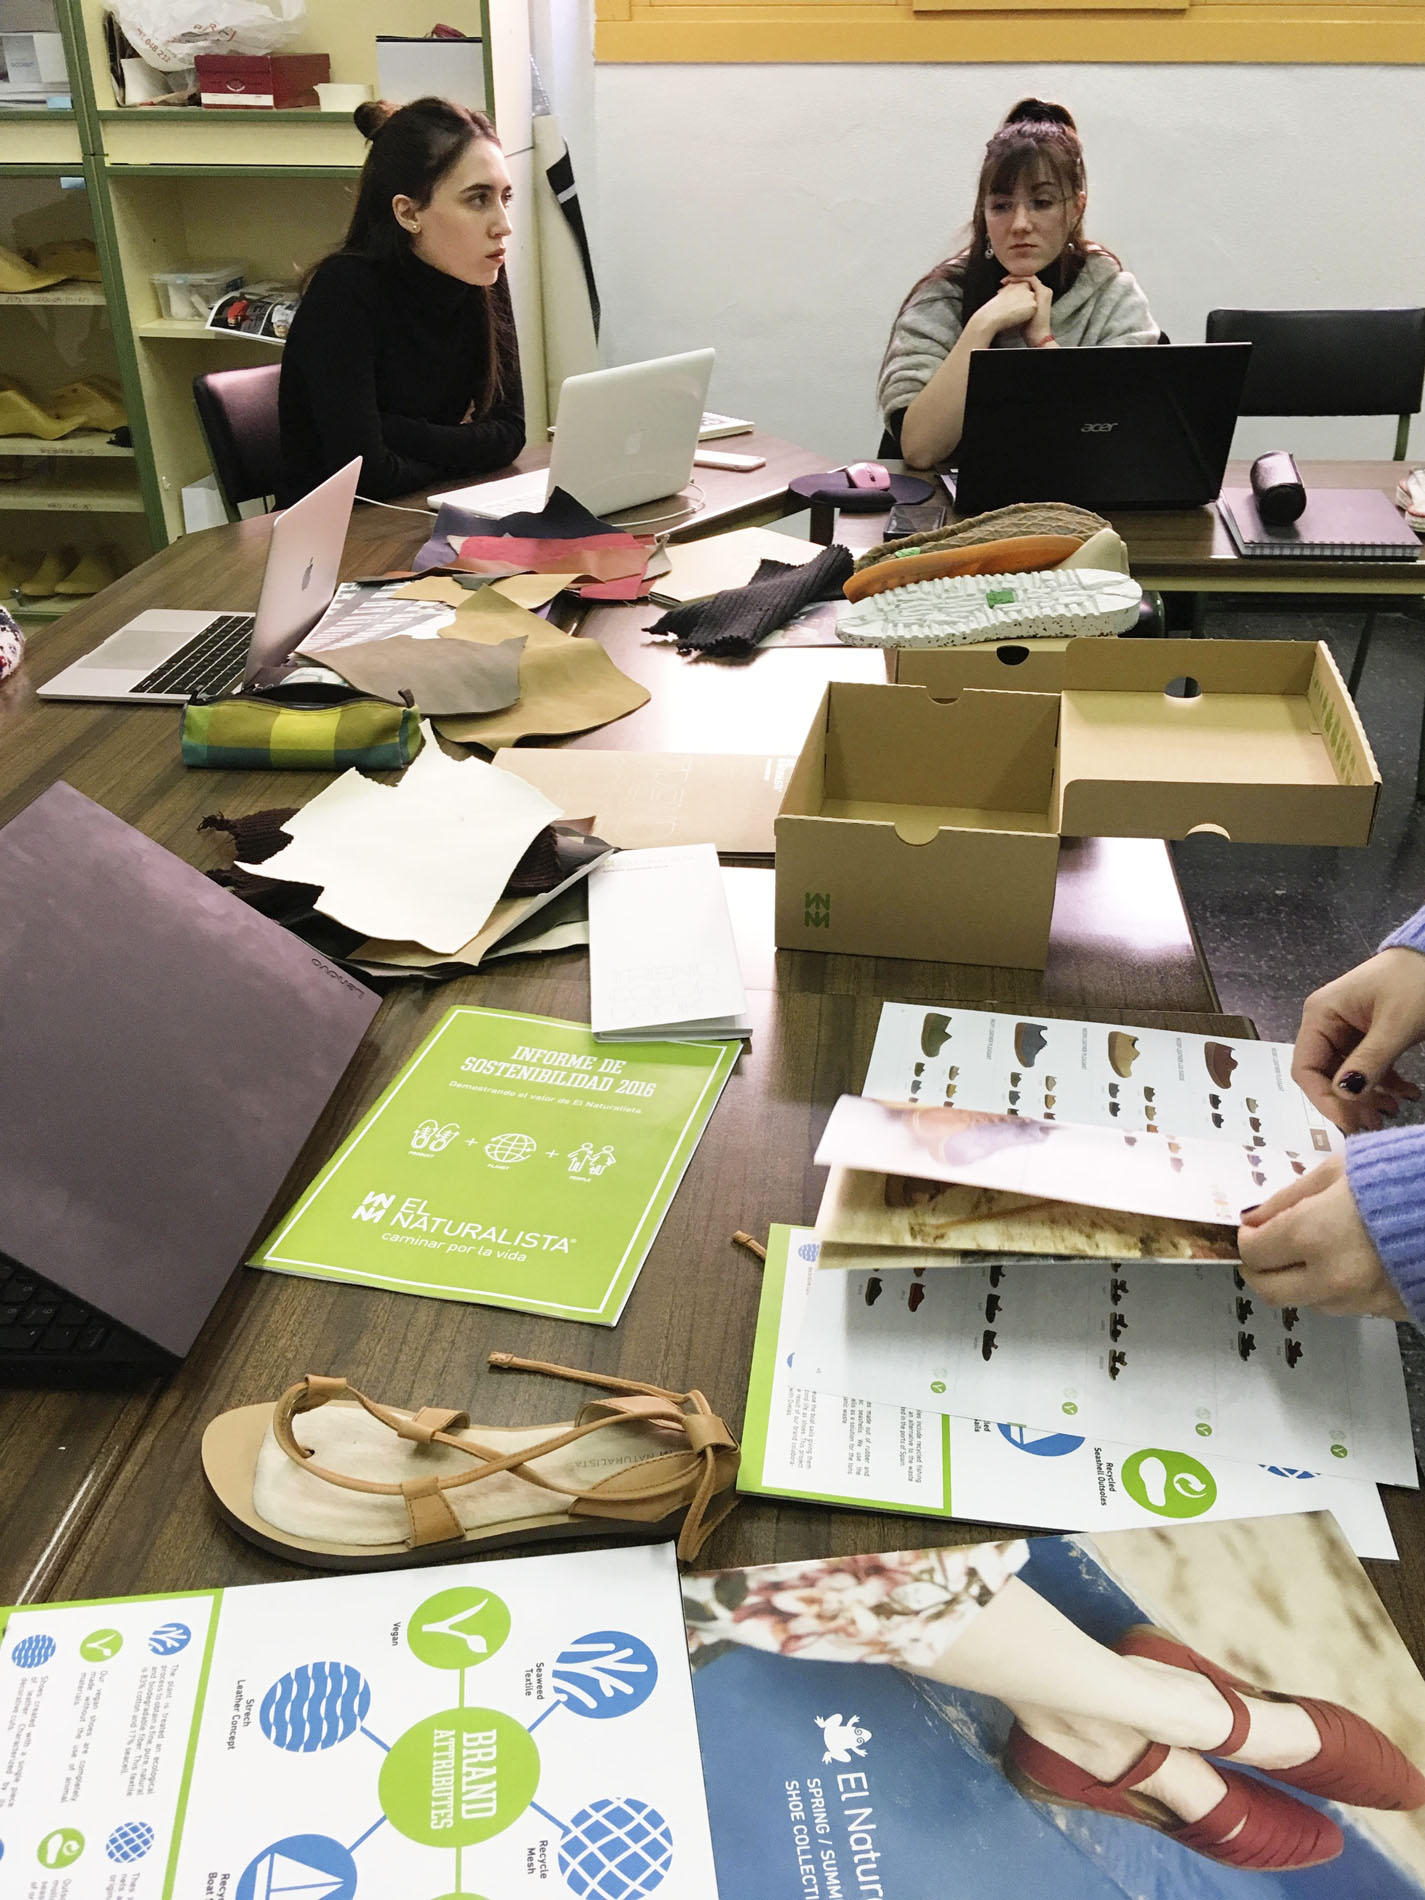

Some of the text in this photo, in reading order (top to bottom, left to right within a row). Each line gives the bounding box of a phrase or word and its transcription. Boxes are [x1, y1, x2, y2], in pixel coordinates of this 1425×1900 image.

[1081, 423, 1119, 432] acer
[312, 959, 364, 999] Lenovo
[511, 1046, 627, 1074] INFORME DE
[460, 1057, 656, 1097] SOSTENIBILIDAD 2016
[449, 1080, 516, 1097] Demostrando
[530, 1094, 556, 1103] valor
[400, 1197, 432, 1216] EL
[389, 1212, 570, 1254] NATURALISTA
[382, 1231, 527, 1262] caminar por la vida
[915, 1441, 923, 1462] recycled
[915, 1465, 923, 1483] fishing
[1094, 1448, 1107, 1506] Seashell Outsoles
[1106, 1463, 1117, 1492] Recycled
[390, 1622, 401, 1646] Vegan
[87, 1672, 96, 1690] made
[150, 1666, 158, 1678] and
[157, 1665, 167, 1692] process
[169, 1664, 179, 1676] The
[525, 1668, 534, 1696] Textile
[535, 1662, 544, 1700] Seaweed
[13, 1678, 27, 1713] decorative
[36, 1676, 48, 1697] Shoes
[166, 1681, 174, 1698] plant
[29, 1701, 40, 1727] created
[80, 1697, 90, 1722] without
[134, 1691, 144, 1712] cotton
[139, 1681, 155, 1730] biodegradable
[151, 1702, 160, 1724] obtain
[243, 1699, 255, 1727] Strech
[130, 1715, 139, 1728] and
[158, 1713, 168, 1738] treated
[227, 1680, 246, 1750] Leather Concept
[24, 1732, 33, 1747] with
[71, 1671, 108, 1802] Our vegan shoes are completely
[76, 1728, 84, 1739] the
[6, 1724, 26, 1774] Characterized
[156, 1744, 162, 1752] an
[14, 1761, 24, 1782] single
[132, 1755, 141, 1770] This
[147, 1757, 160, 1794] ecological
[461, 1728, 497, 1819] BRAND
[61, 1777, 72, 1803] animal
[126, 1773, 137, 1796] textile
[137, 1769, 148, 1795] natural
[430, 1728, 456, 1829] ATTRIBUTES
[785, 1780, 805, 1821] SHOE
[807, 1778, 830, 1834] SPRING
[820, 1849, 843, 1900] SUMM
[837, 1772, 884, 1900] El Natur
[527, 1847, 536, 1874] Mesh
[537, 1840, 549, 1879] Recycle
[206, 1872, 217, 1895] Boat
